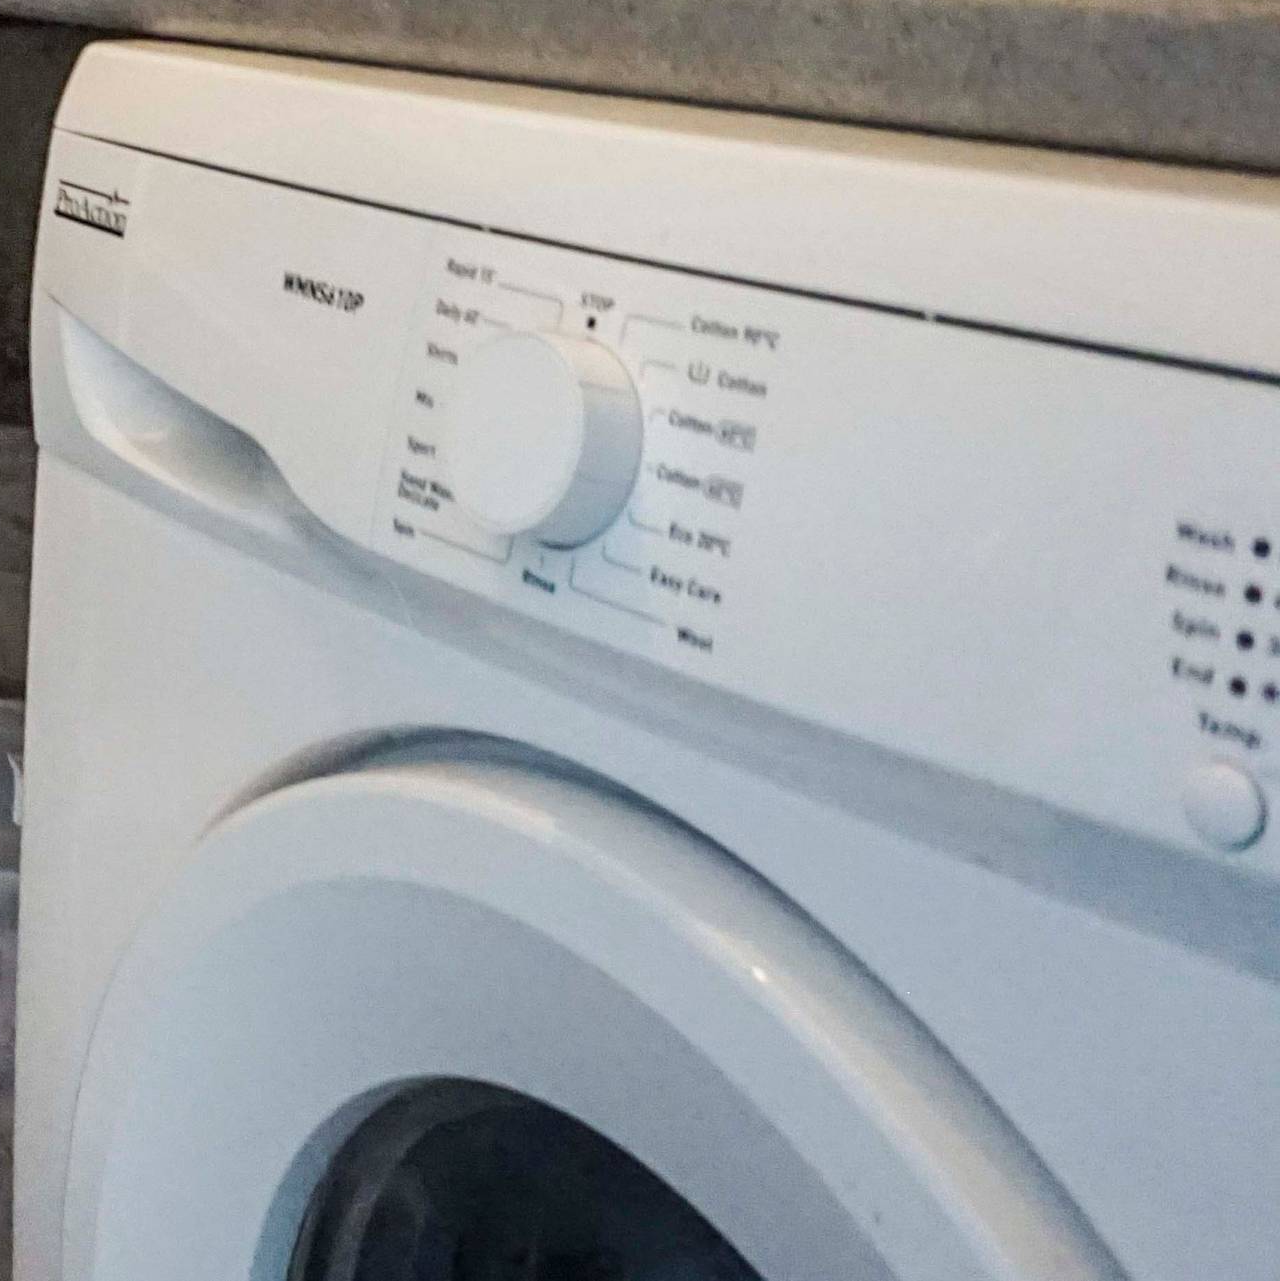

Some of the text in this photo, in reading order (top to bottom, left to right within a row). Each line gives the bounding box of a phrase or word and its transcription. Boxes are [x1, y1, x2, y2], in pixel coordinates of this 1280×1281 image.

[580, 291, 616, 312] STOP
[691, 313, 738, 340] Cotton
[718, 369, 768, 399] Cotton
[669, 408, 714, 436] Cotton
[657, 463, 701, 489] Cotton
[669, 522, 693, 545] Eco
[1178, 523, 1236, 552] Wash
[650, 566, 722, 604] Easy Care
[1166, 562, 1226, 597] Rinse
[1172, 610, 1221, 640] Spin
[677, 625, 715, 655] Wool
[1172, 656, 1215, 686] End
